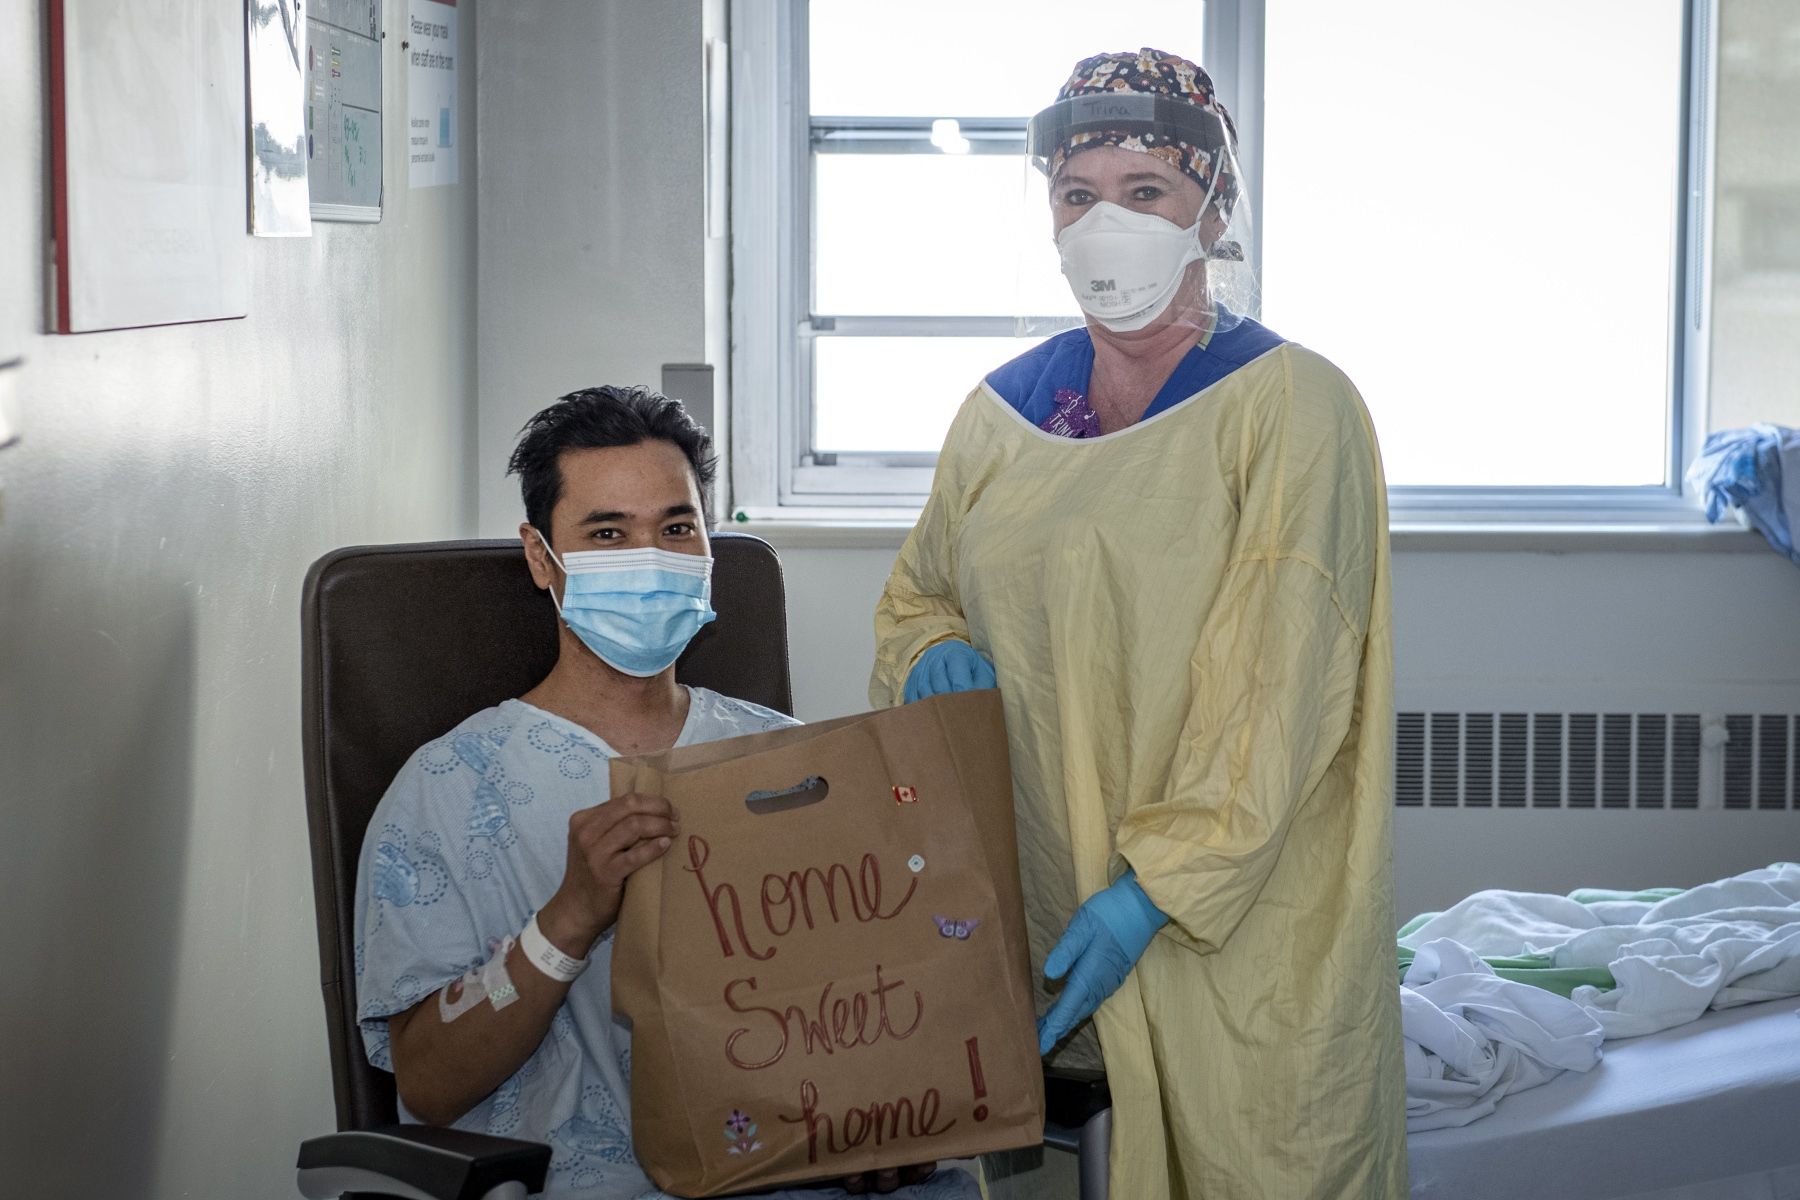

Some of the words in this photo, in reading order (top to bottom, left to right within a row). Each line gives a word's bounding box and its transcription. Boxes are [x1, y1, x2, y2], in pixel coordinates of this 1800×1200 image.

[1082, 101, 1131, 116] Trina
[1091, 280, 1116, 292] 3M
[683, 835, 919, 961] home
[723, 964, 924, 1071] Sweet
